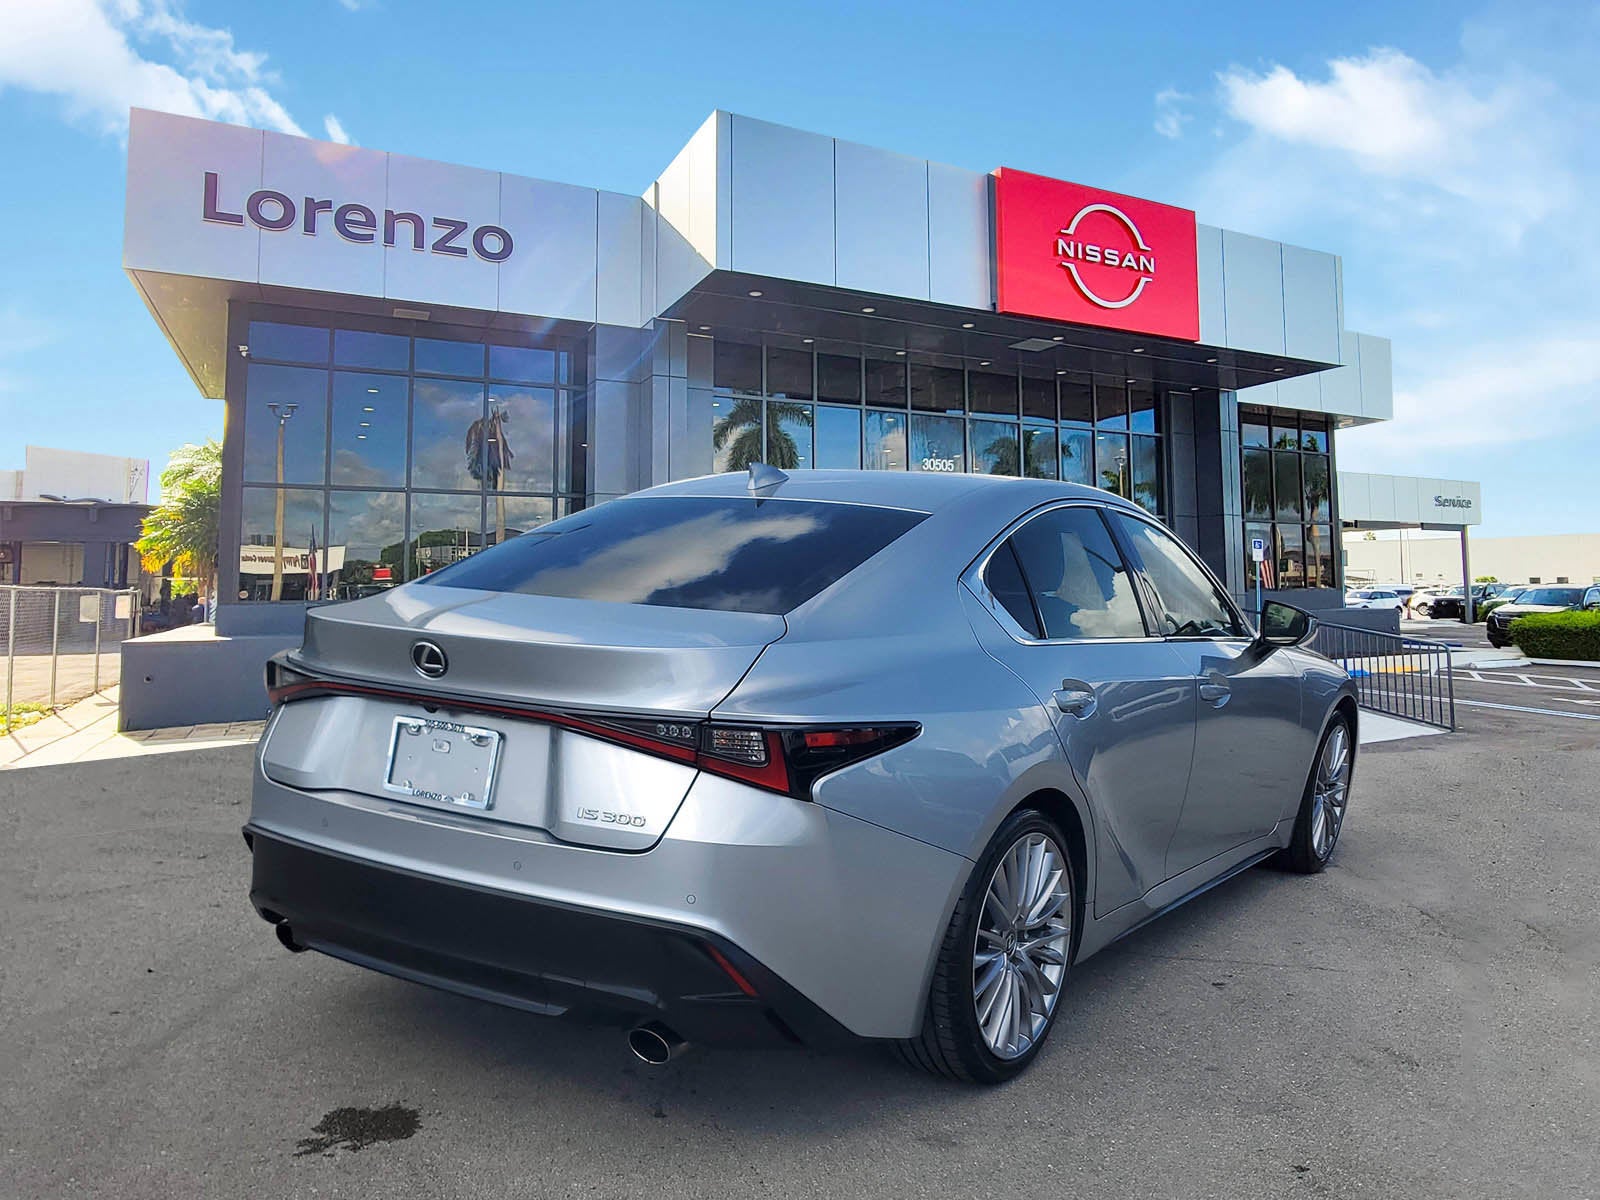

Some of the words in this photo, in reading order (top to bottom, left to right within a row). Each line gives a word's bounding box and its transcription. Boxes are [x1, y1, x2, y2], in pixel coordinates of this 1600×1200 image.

[203, 171, 514, 262] Lorenzo
[1057, 238, 1155, 273] NISSAN
[922, 457, 955, 472] 30505
[1433, 495, 1472, 509] Service
[412, 789, 443, 801] LORENZO
[576, 807, 599, 821] IS
[600, 811, 647, 828] 300
